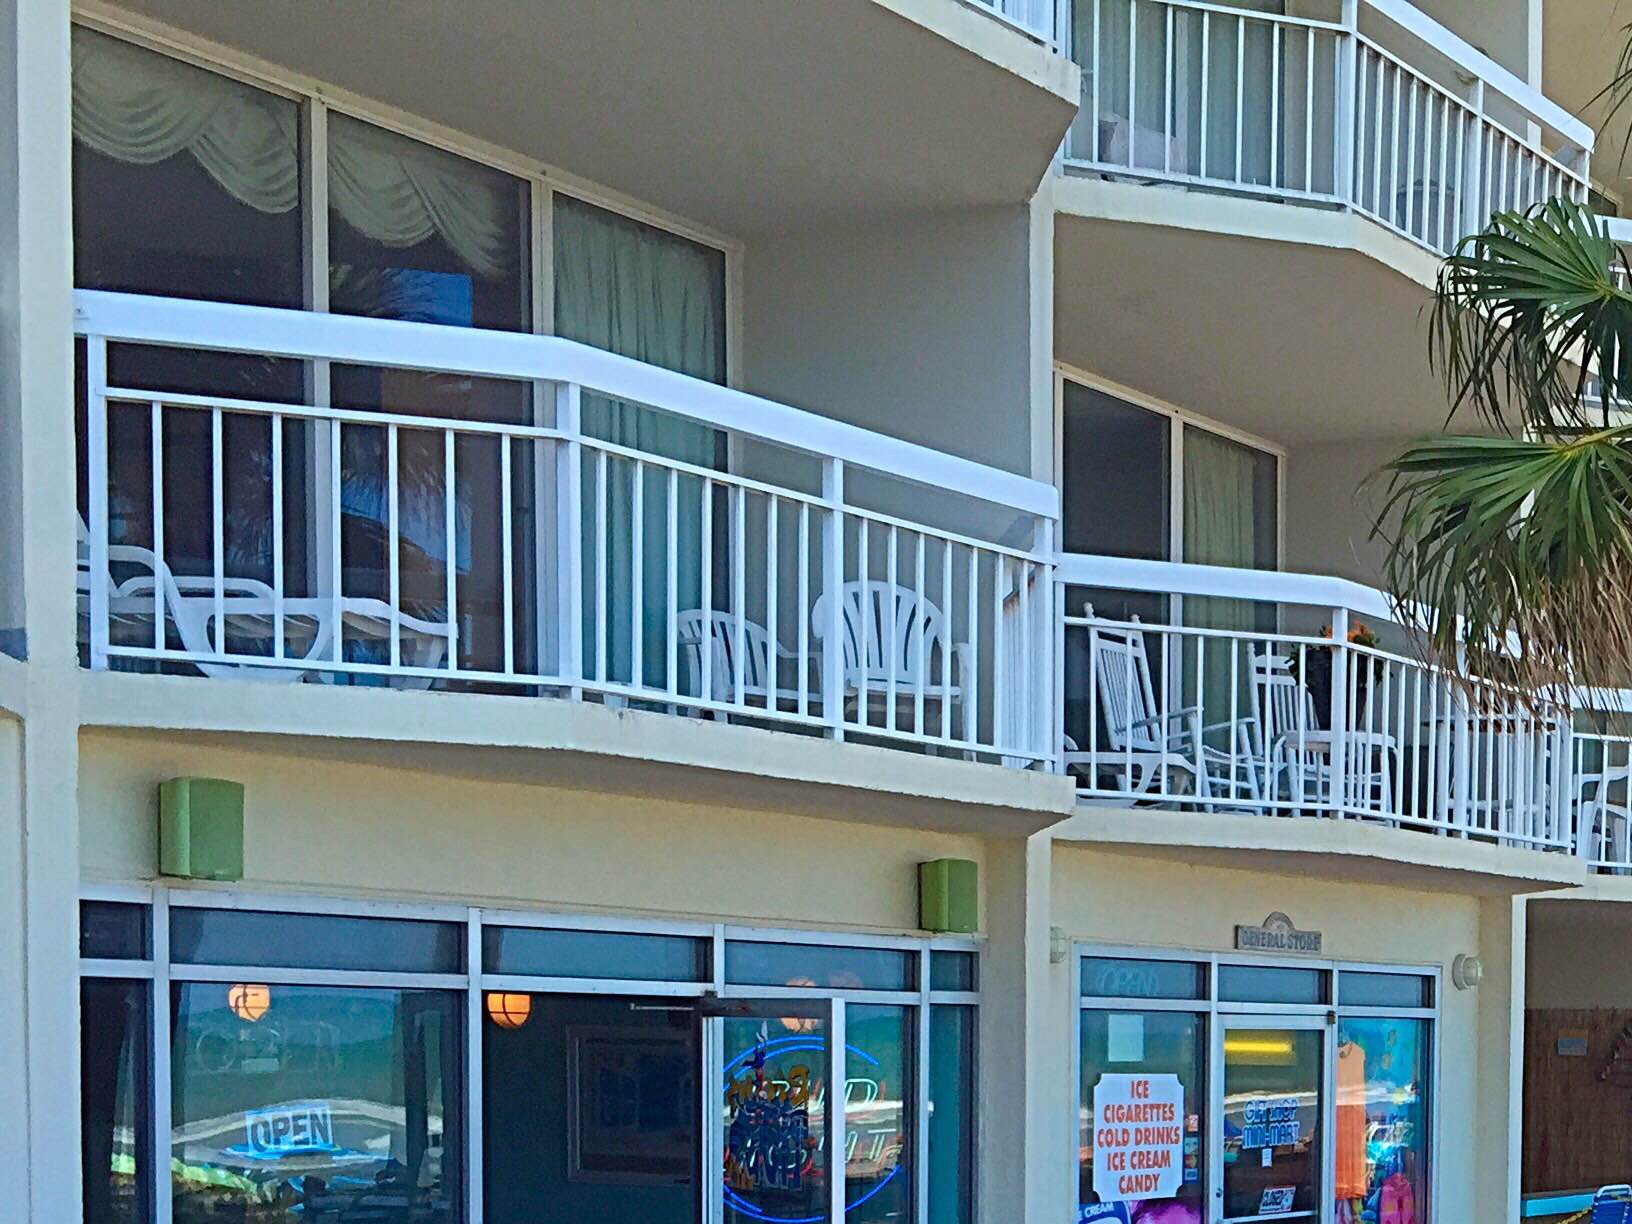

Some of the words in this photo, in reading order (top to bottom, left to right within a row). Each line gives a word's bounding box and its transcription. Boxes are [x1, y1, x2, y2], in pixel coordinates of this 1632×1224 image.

[1241, 928, 1286, 949] GENERAL
[1287, 933, 1321, 952] STORE
[1130, 1080, 1150, 1099] ICE
[1103, 1103, 1175, 1123] CIGARETTES
[250, 1113, 332, 1152] OPEN
[1097, 1128, 1130, 1148] COLD
[1134, 1126, 1180, 1146] DRINKS
[1107, 1152, 1126, 1171] ICE
[1130, 1150, 1171, 1170] CREAM
[1119, 1174, 1160, 1194] CANDY
[1084, 1202, 1115, 1218] CREAM
